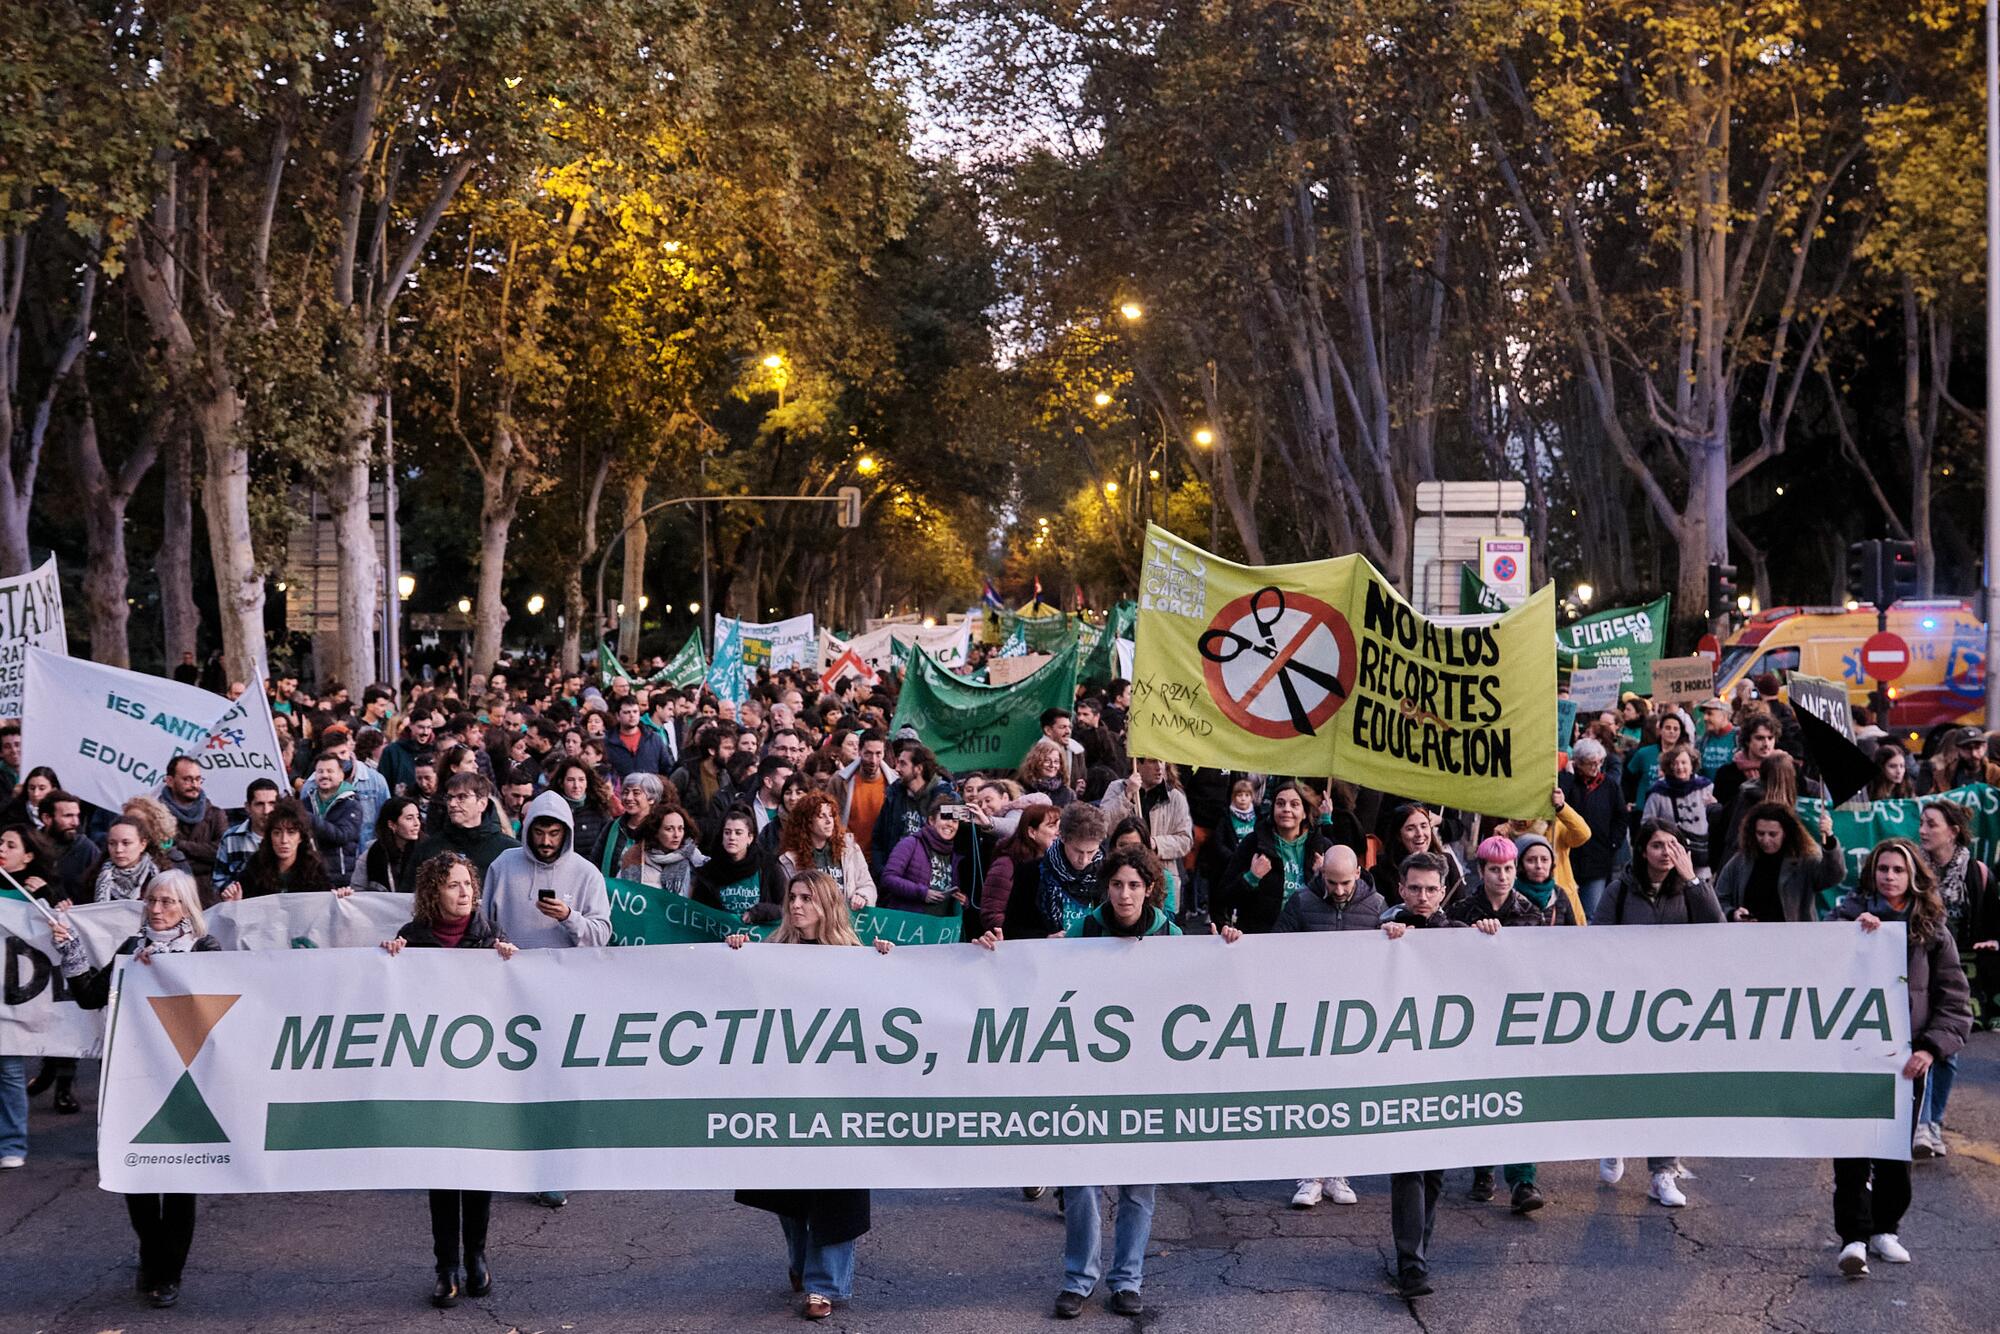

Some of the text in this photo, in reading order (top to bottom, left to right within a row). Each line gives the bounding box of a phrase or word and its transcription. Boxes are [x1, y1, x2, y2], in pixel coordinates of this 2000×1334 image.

[1152, 539, 1206, 577] IES
[1141, 593, 1204, 619] LORCA
[1364, 579, 1500, 667] NO A LOS
[1571, 611, 1652, 647] PICASSO
[1161, 683, 1202, 711] ROZAS
[1359, 636, 1502, 722] RECORTES
[1671, 678, 1712, 694] 18 HORAS
[1353, 694, 1512, 777] EDUCACIÓN
[609, 888, 647, 916] NO
[853, 912, 889, 934] EN
[896, 920, 925, 944] LA
[271, 987, 1893, 1076] MENOS LECTIVAS, MÁS CALIDAD EDUCATIVA
[708, 1091, 1523, 1140] POR LA RECUPERACIÓN DE NUESTROS DERECHOS
[124, 1152, 231, 1167] @menoslectivas
